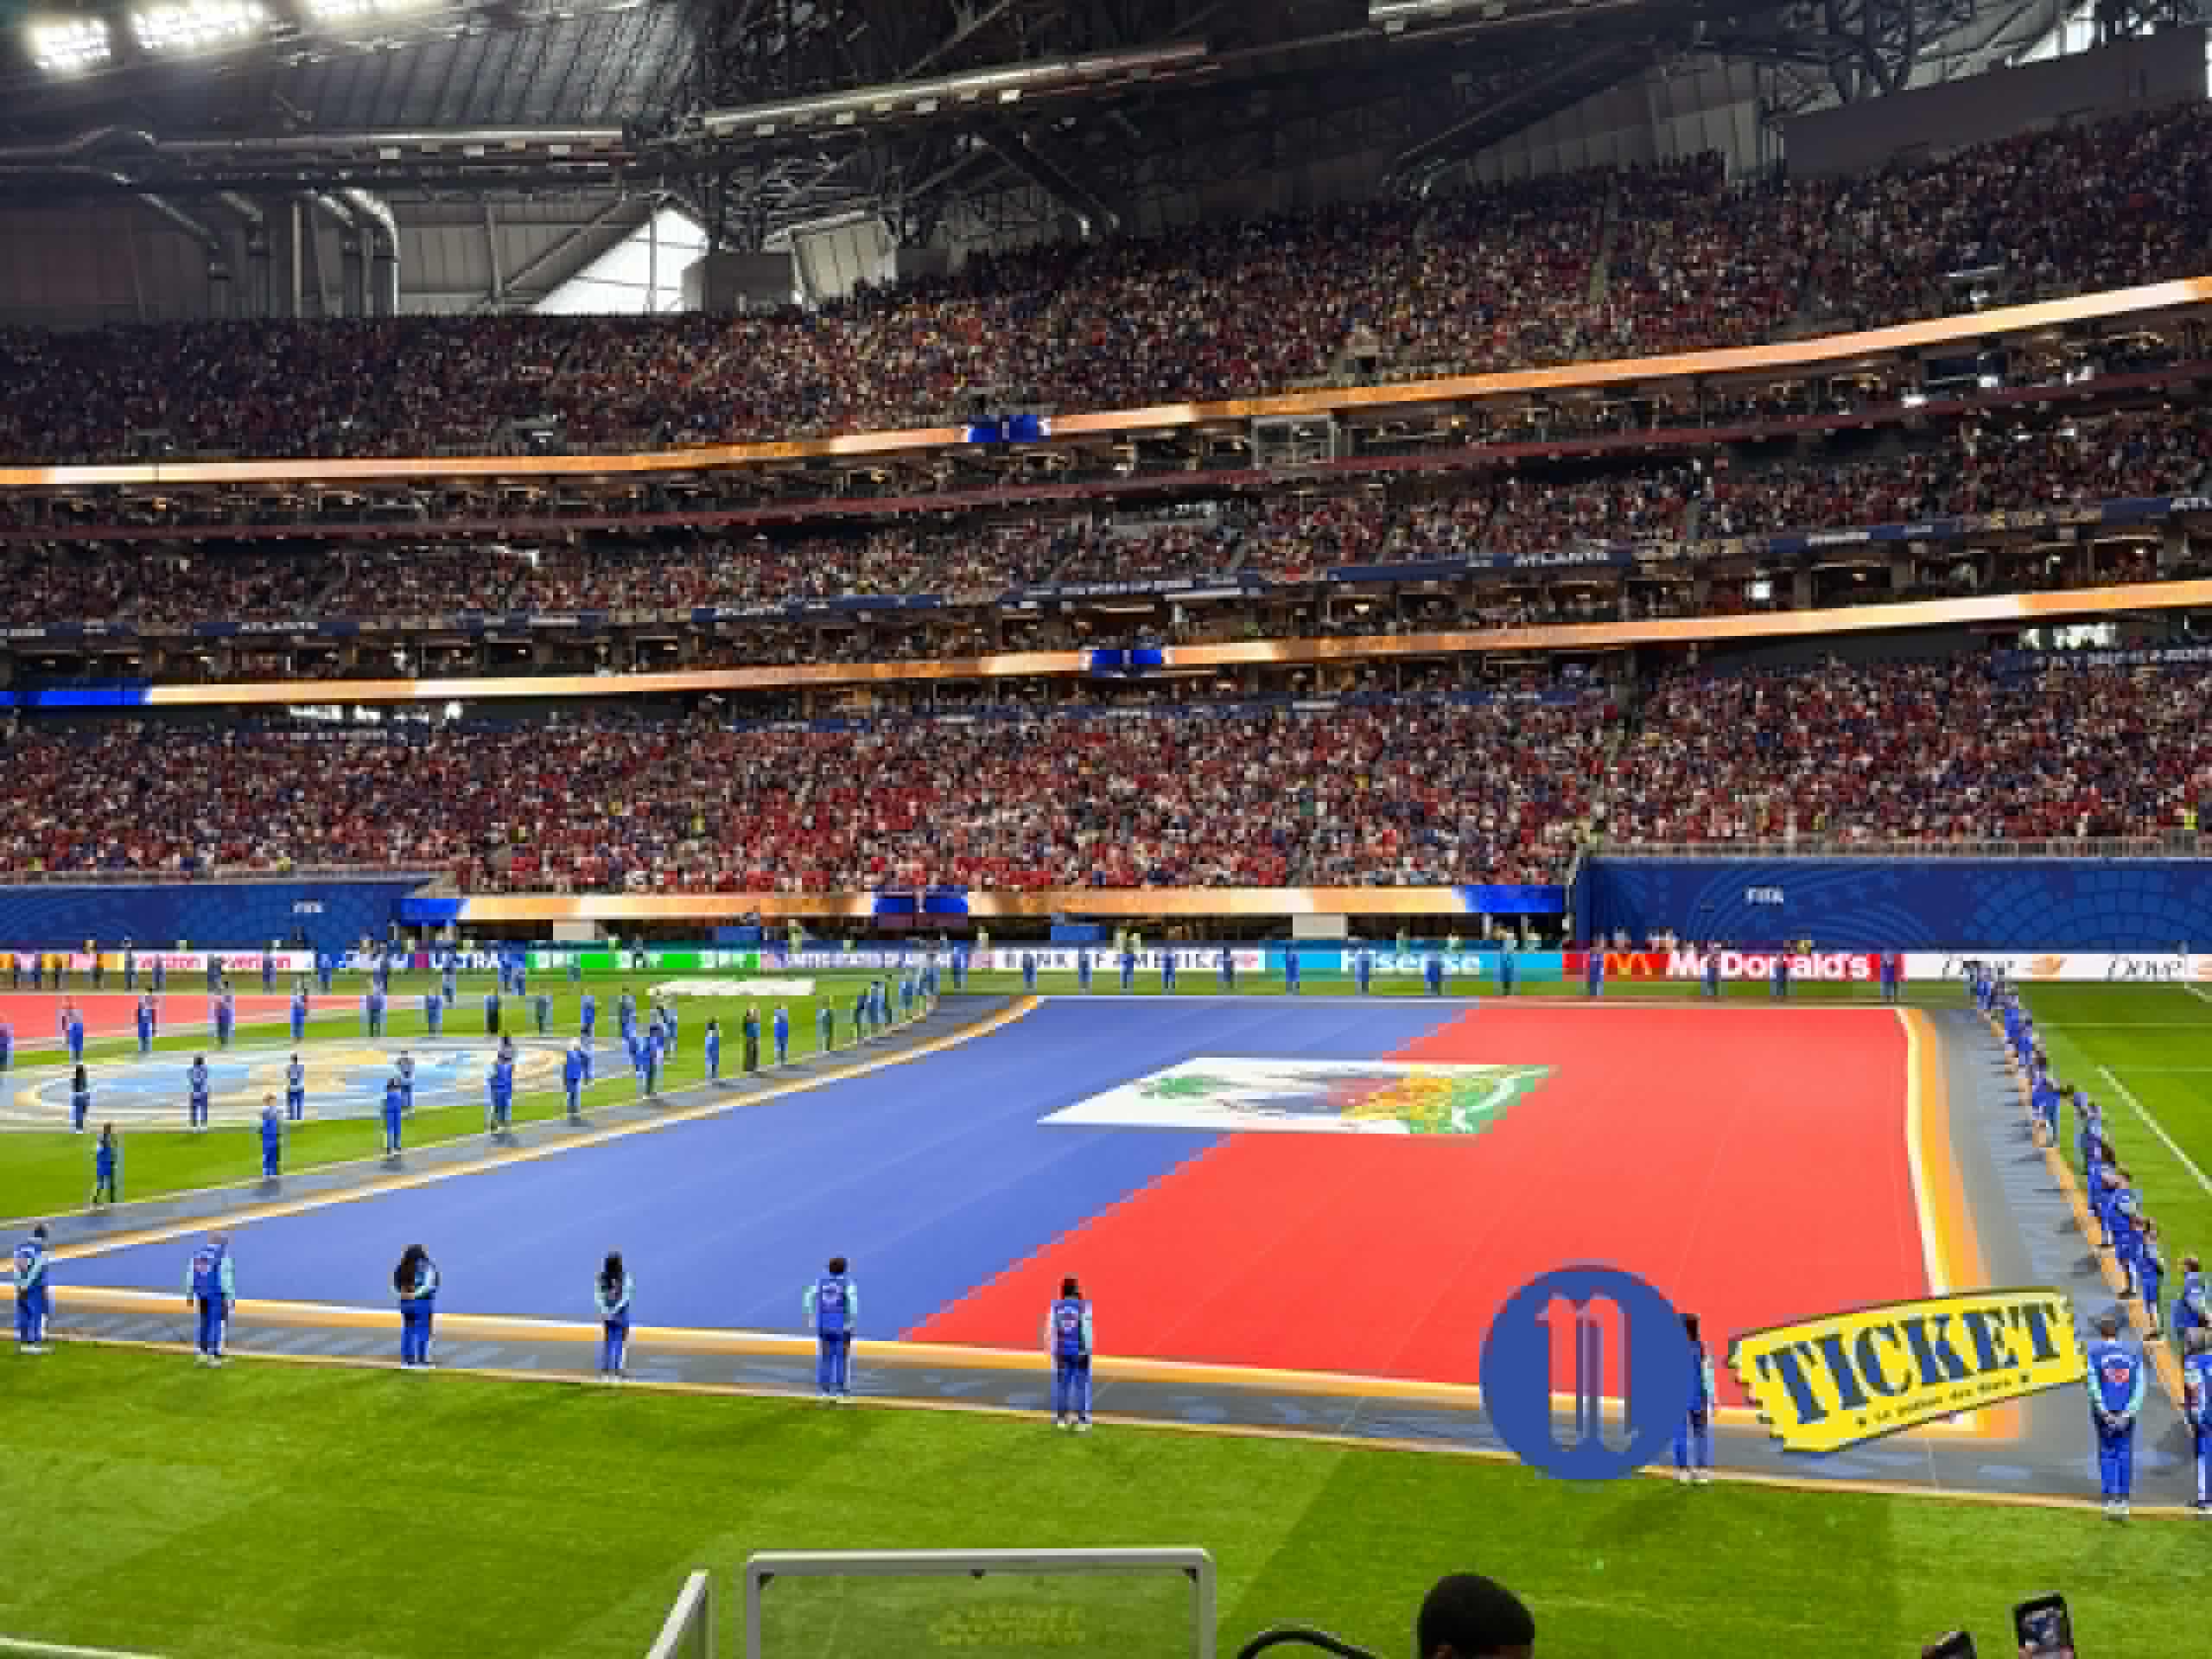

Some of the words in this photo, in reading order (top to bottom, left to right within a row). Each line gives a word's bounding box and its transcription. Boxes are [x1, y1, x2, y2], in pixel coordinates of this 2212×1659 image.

[138, 954, 197, 969] veizon
[1113, 953, 1222, 968] AMEICA
[1943, 954, 2016, 977] Dve
